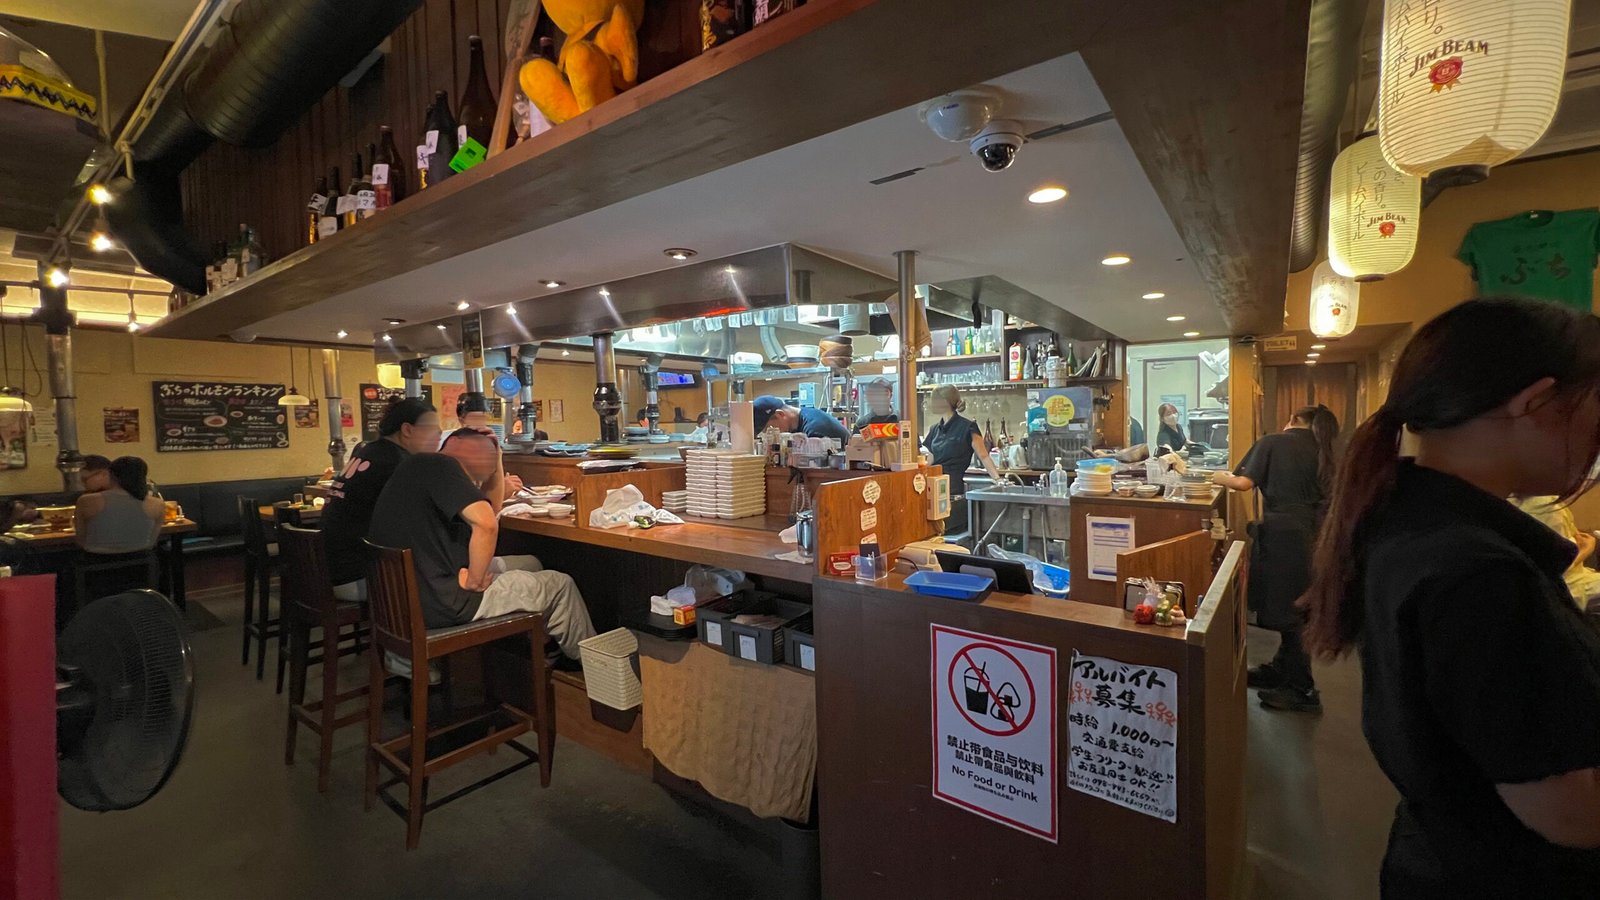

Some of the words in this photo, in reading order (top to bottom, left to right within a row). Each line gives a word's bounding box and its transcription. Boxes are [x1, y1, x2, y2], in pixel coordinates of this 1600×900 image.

[1409, 46, 1438, 78] JIM
[1441, 38, 1489, 57] BEAM
[1367, 215, 1384, 228] JIM
[160, 383, 283, 398] ぶちのホルモンランキング
[1072, 660, 1166, 689] アルバイト
[1092, 683, 1146, 716] 募集
[1069, 712, 1099, 730] 時給
[1082, 731, 1145, 759] 交通費支給
[952, 764, 966, 777] No
[967, 770, 993, 787] Food
[995, 782, 1006, 792] or
[1008, 785, 1038, 803] Drink
